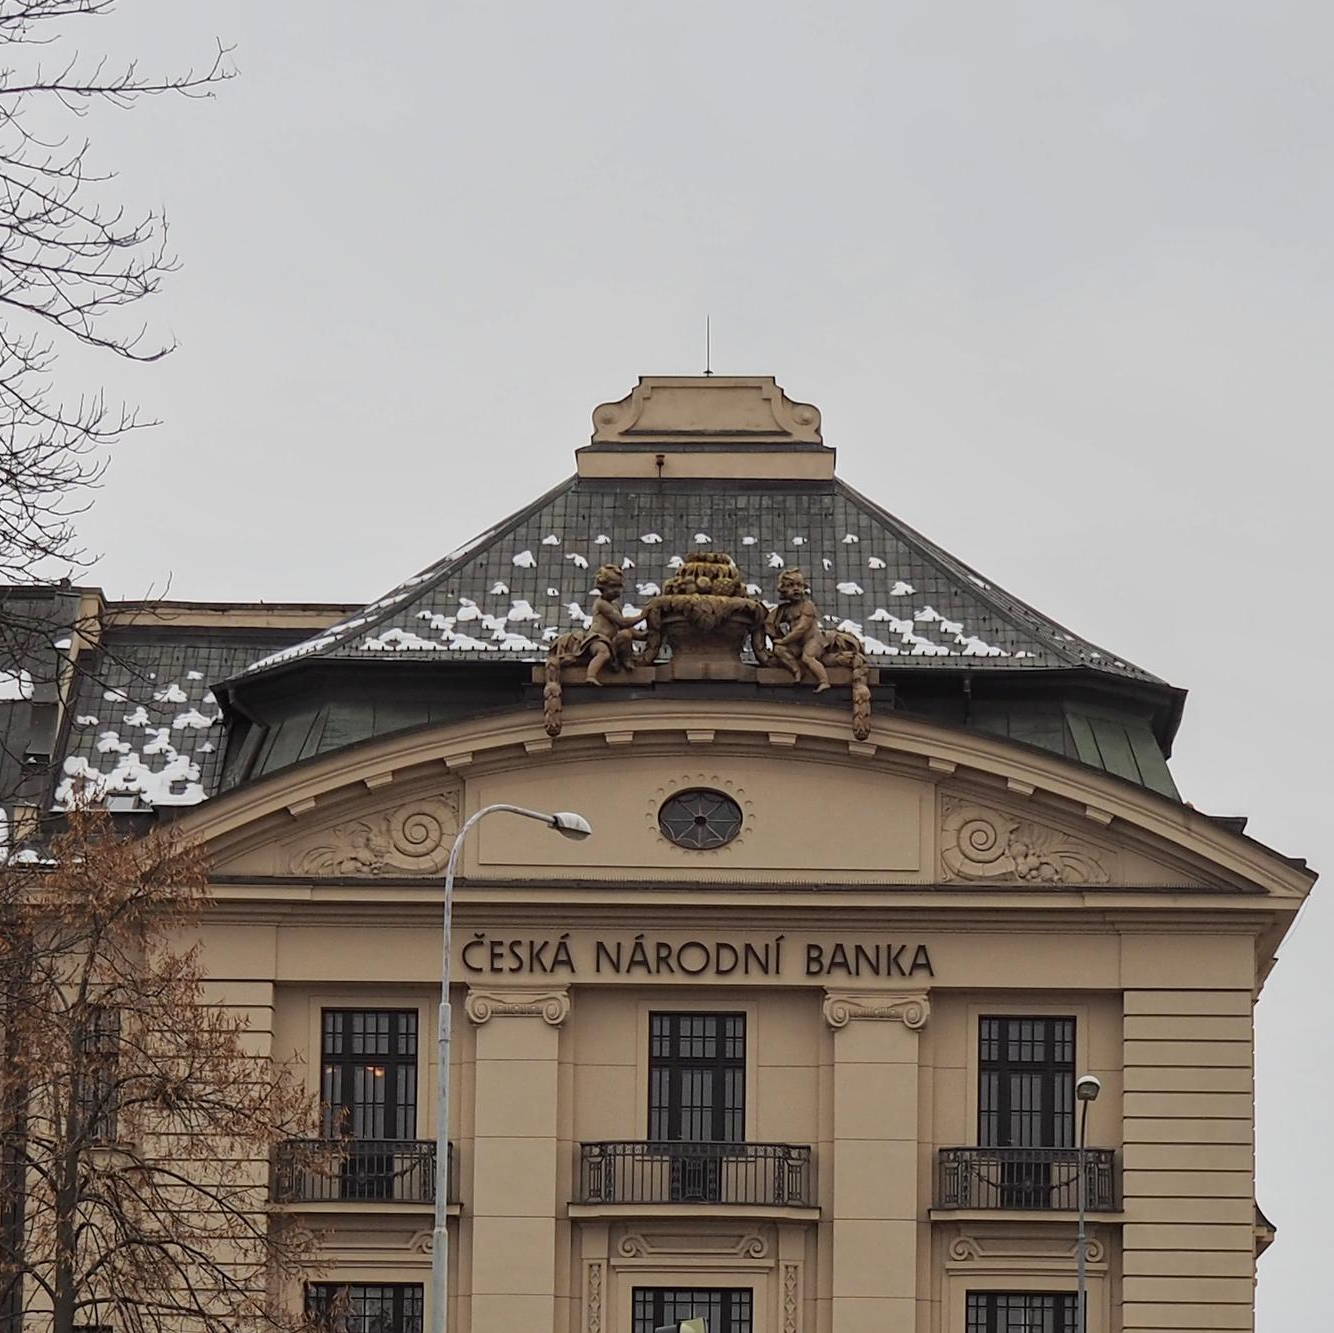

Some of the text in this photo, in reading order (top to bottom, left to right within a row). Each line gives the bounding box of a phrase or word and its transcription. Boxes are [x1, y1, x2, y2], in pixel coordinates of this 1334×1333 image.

[462, 932, 935, 976] ČESKÁ NÁRODNÍ BANKA
